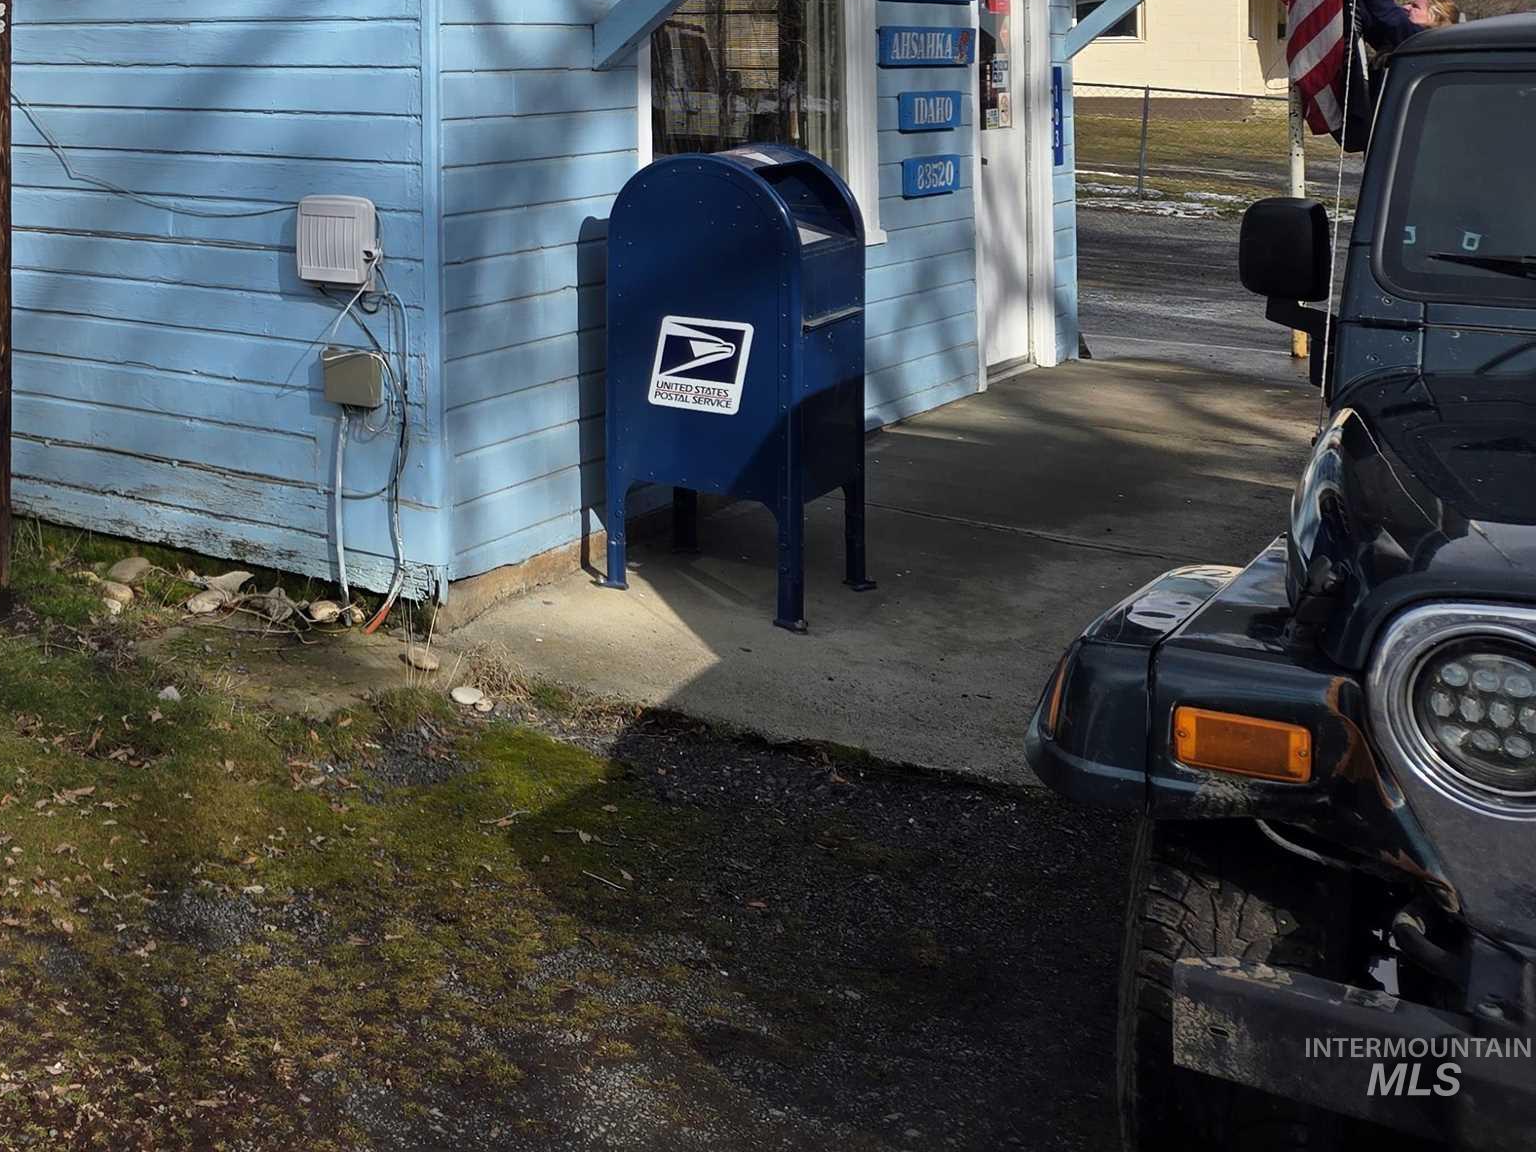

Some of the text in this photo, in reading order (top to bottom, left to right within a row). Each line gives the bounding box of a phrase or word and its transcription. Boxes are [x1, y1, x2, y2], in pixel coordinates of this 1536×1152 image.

[891, 32, 953, 60] AHSAHKA
[914, 96, 953, 125] IDAHO
[917, 160, 954, 189] 83520
[654, 391, 733, 409] POSTAL SERVICE
[656, 380, 729, 397] UNITED STATES
